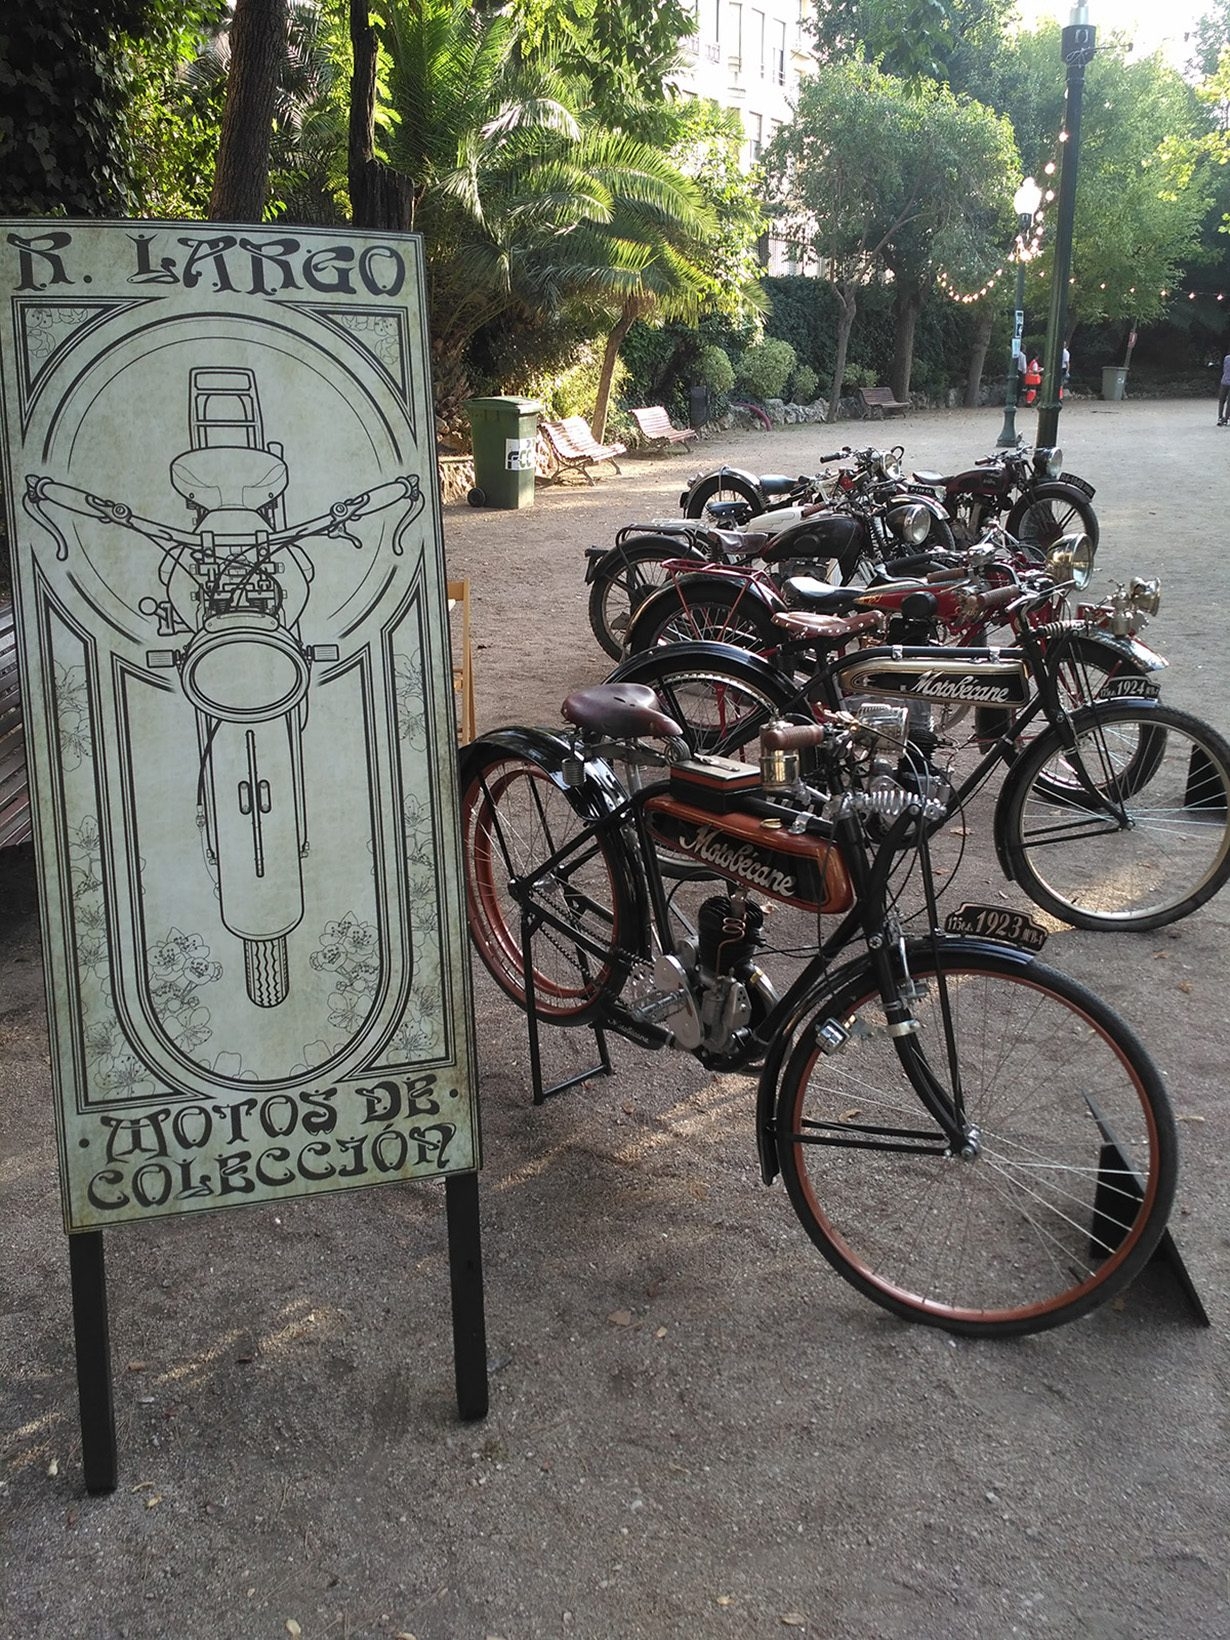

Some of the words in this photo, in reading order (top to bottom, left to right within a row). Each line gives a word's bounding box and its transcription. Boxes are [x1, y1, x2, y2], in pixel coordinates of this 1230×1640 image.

[7, 232, 93, 292] R.
[125, 232, 406, 296] LARGO
[910, 668, 1009, 703] Motobécane
[1117, 680, 1146, 696] 1924
[679, 824, 796, 897] Motobécane
[975, 910, 1023, 939] 1923
[101, 1087, 338, 1163] MOTOS
[355, 1073, 441, 1124] DE
[87, 1122, 457, 1210] COLECCIÓN
